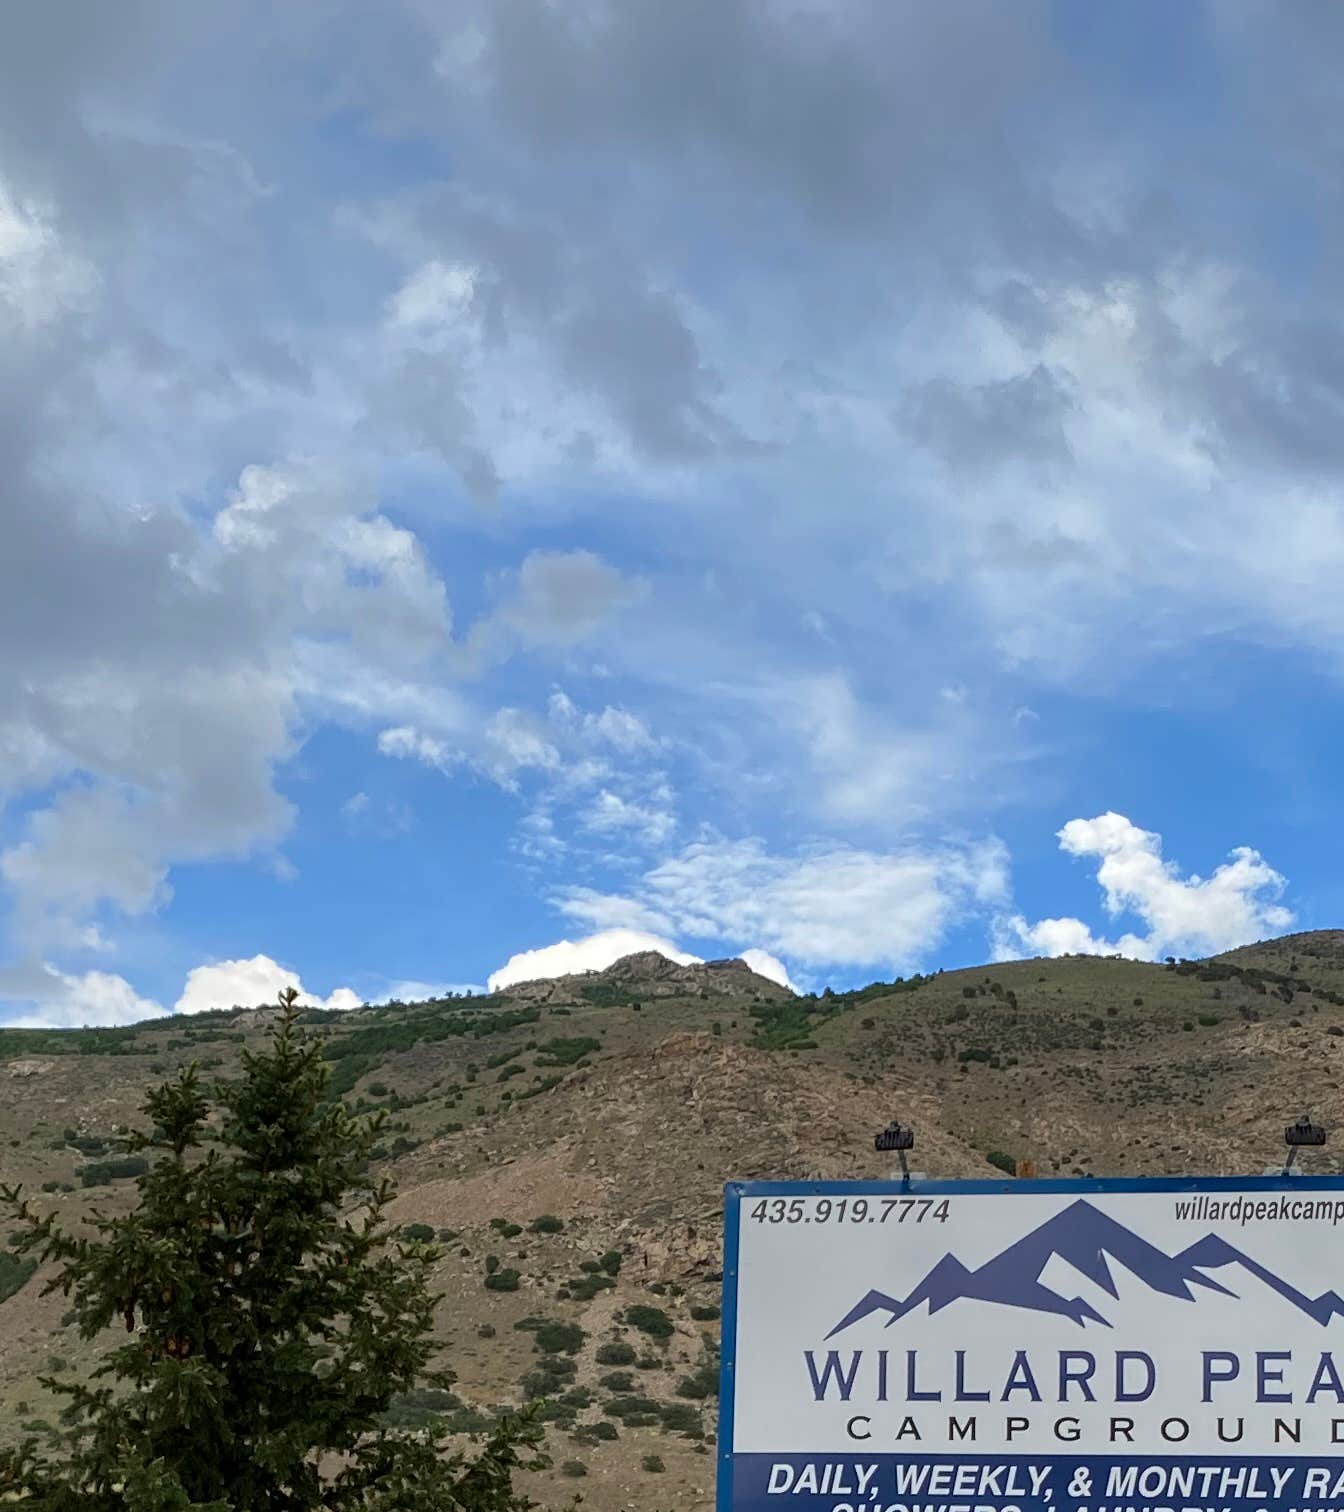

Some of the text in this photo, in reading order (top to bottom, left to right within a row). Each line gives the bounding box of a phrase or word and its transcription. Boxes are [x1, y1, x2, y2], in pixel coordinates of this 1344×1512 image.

[750, 1199, 951, 1224] 435.919.7774
[803, 1349, 1157, 1403] WILLARD
[767, 1463, 879, 1501] DAILY,
[895, 1464, 1053, 1503] WEEKLY,
[1066, 1466, 1094, 1497] &
[1105, 1465, 1295, 1500] MONTHLY
